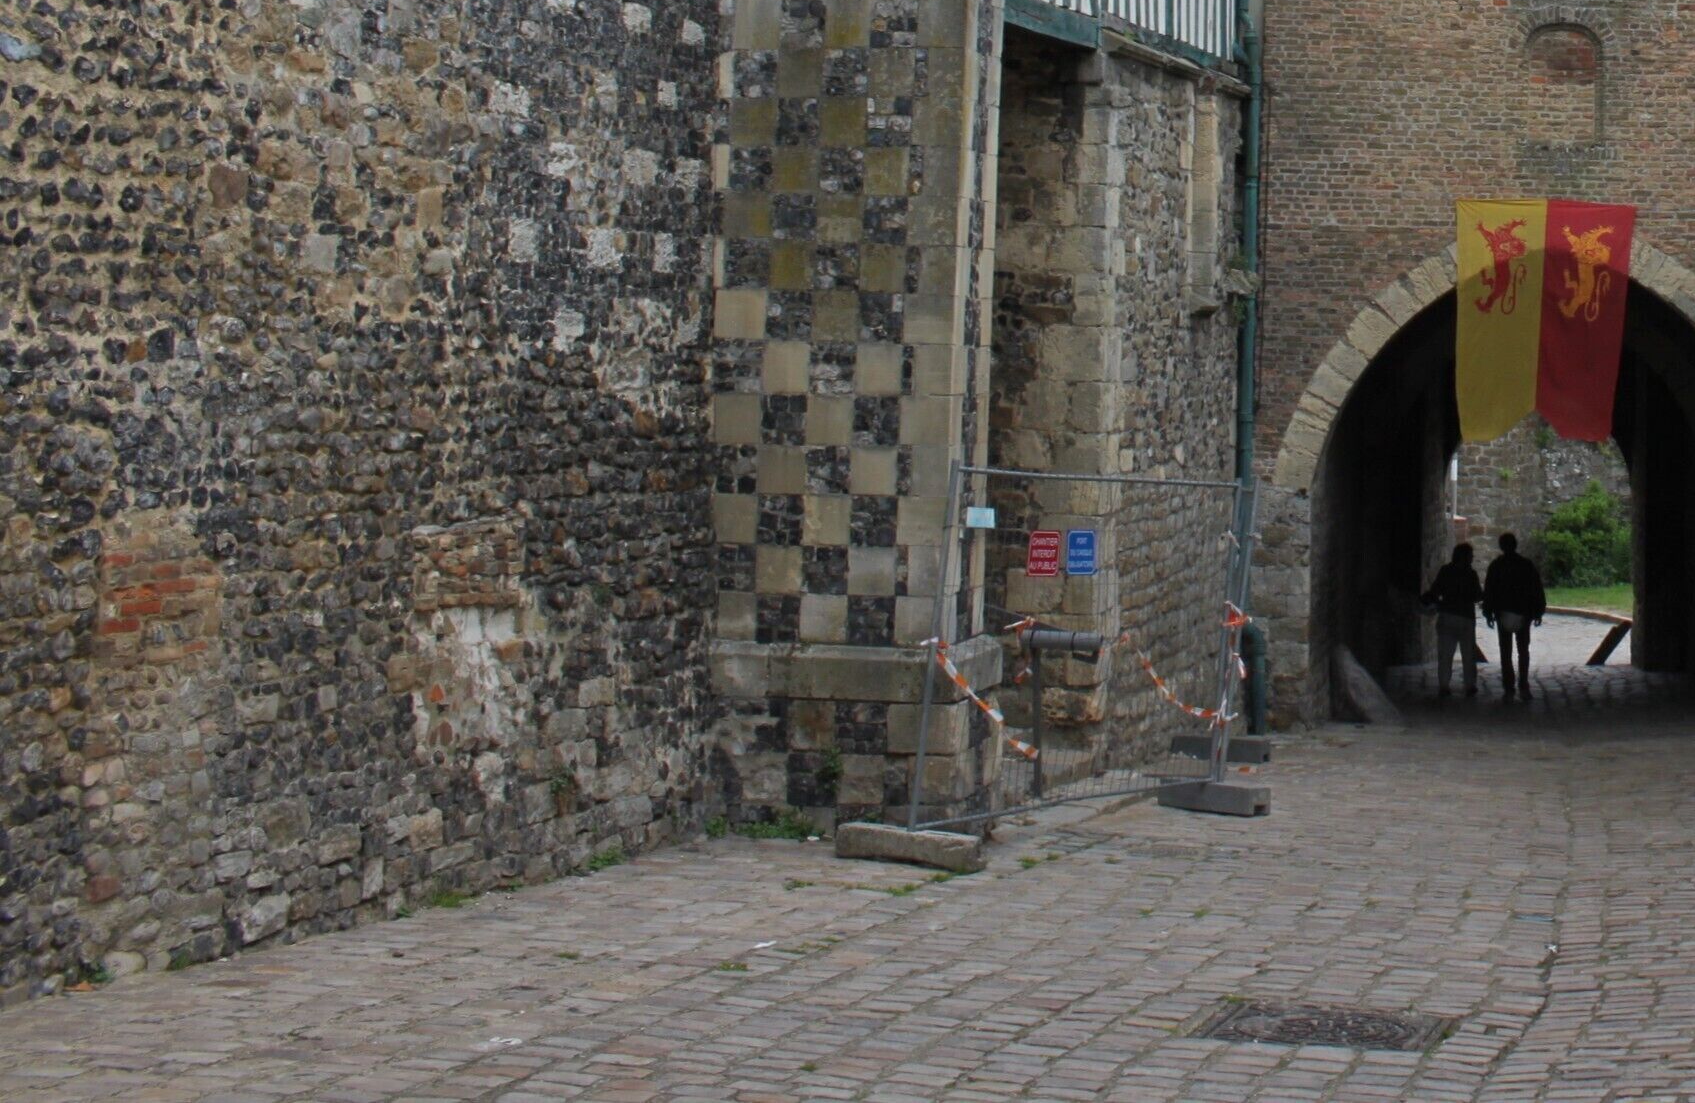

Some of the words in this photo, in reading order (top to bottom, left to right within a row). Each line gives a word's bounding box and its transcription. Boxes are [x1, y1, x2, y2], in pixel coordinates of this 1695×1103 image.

[1032, 537, 1058, 546] CHANTIER
[1032, 549, 1056, 558] INTERDIT
[1030, 561, 1037, 569] AU
[1038, 562, 1057, 570] PUBLIC
